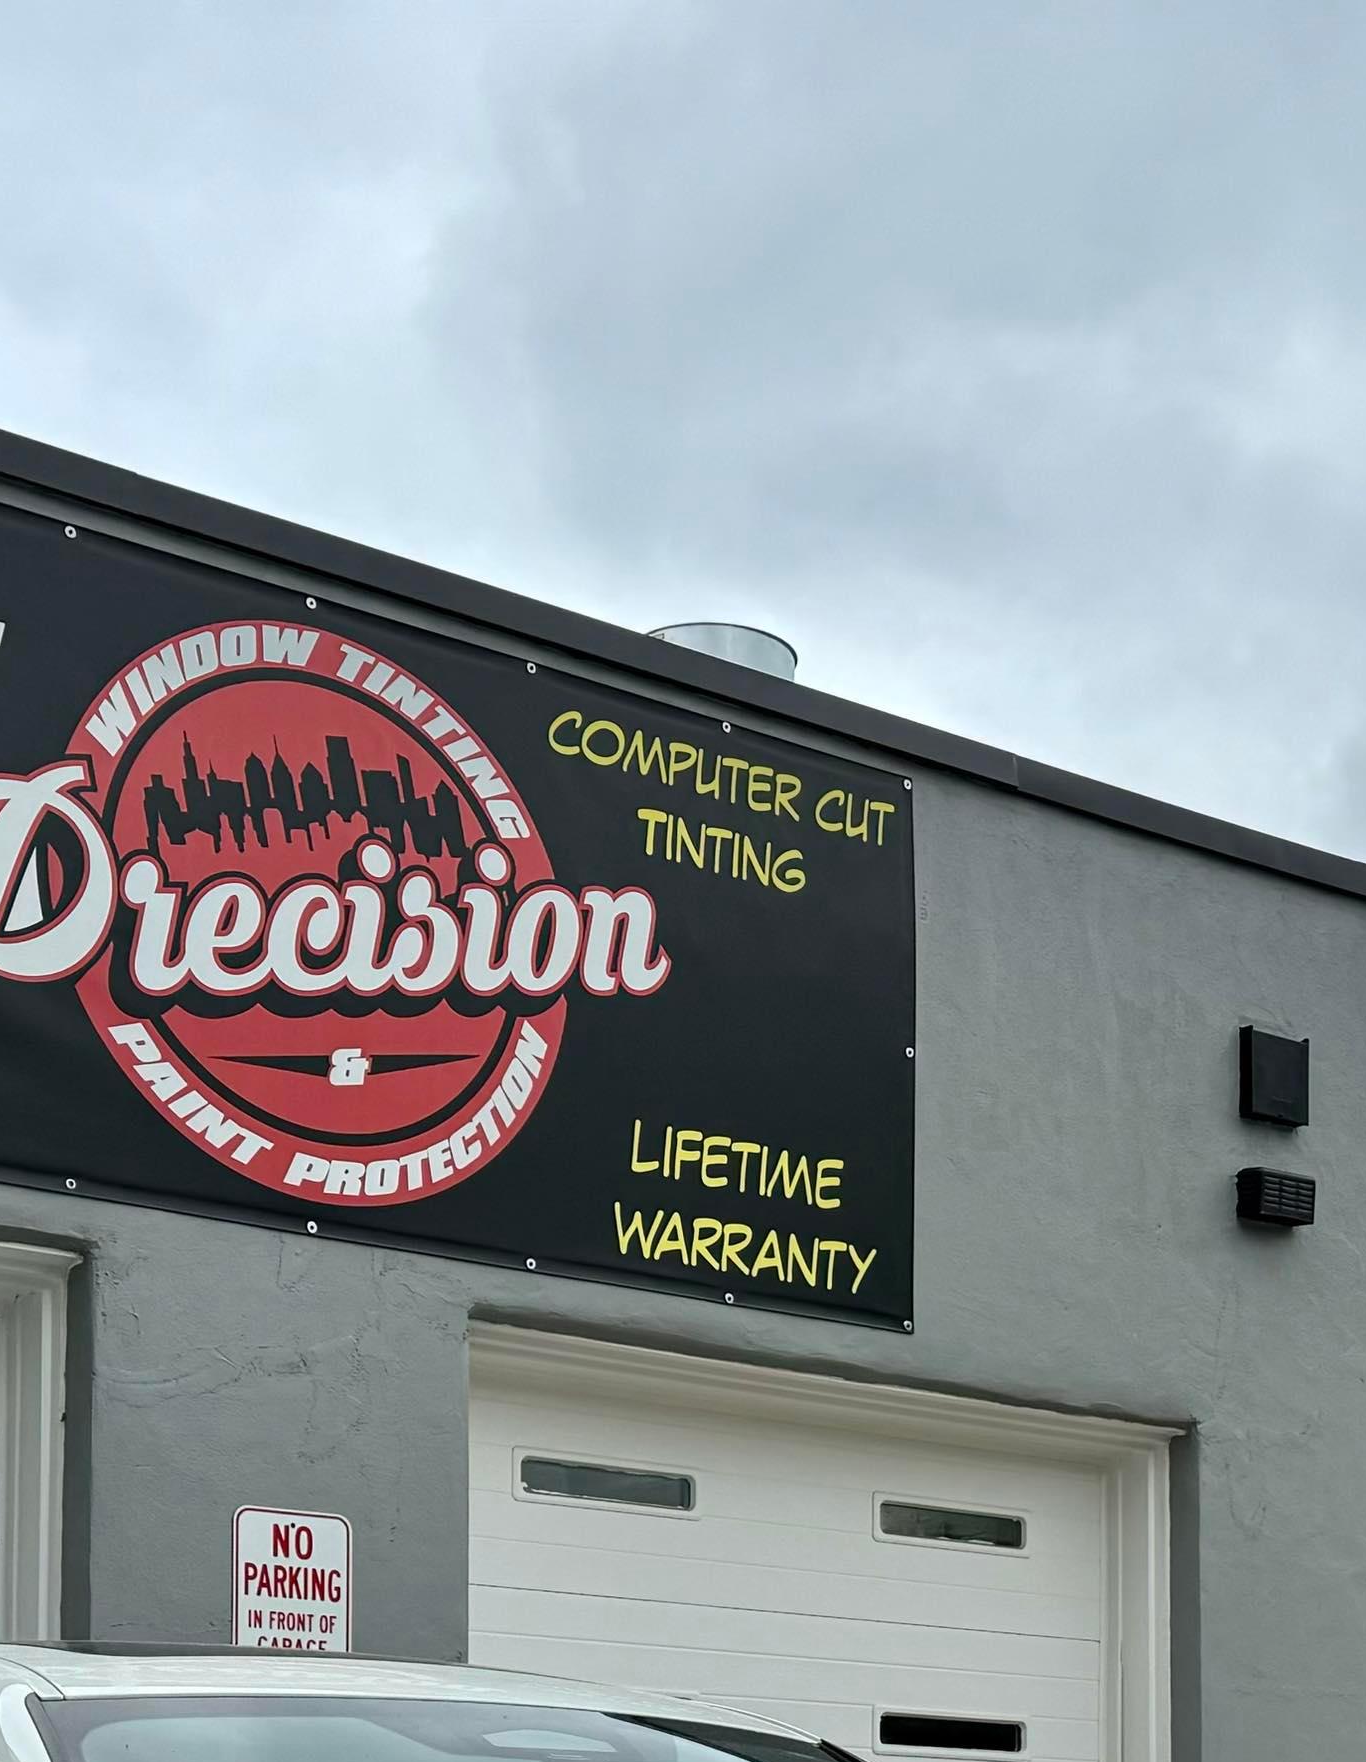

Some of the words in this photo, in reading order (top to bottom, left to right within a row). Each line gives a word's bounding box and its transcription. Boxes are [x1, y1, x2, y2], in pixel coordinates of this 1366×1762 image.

[85, 625, 319, 756] WINDOW
[336, 643, 530, 840] TINTING
[548, 711, 802, 823] COMPUTER
[815, 790, 894, 846] CUT
[637, 808, 806, 893] TINTING
[108, 1022, 274, 1165] PAINT
[284, 1020, 550, 1196] PROTECTION
[327, 1047, 369, 1086] &
[630, 1119, 844, 1209] LIFETIME
[614, 1201, 876, 1293] WARRANTY
[244, 1562, 341, 1603] PARKING
[273, 1523, 313, 1560] NO
[248, 1609, 262, 1628] IN
[269, 1611, 314, 1632] FRONT
[319, 1615, 337, 1634] OF
